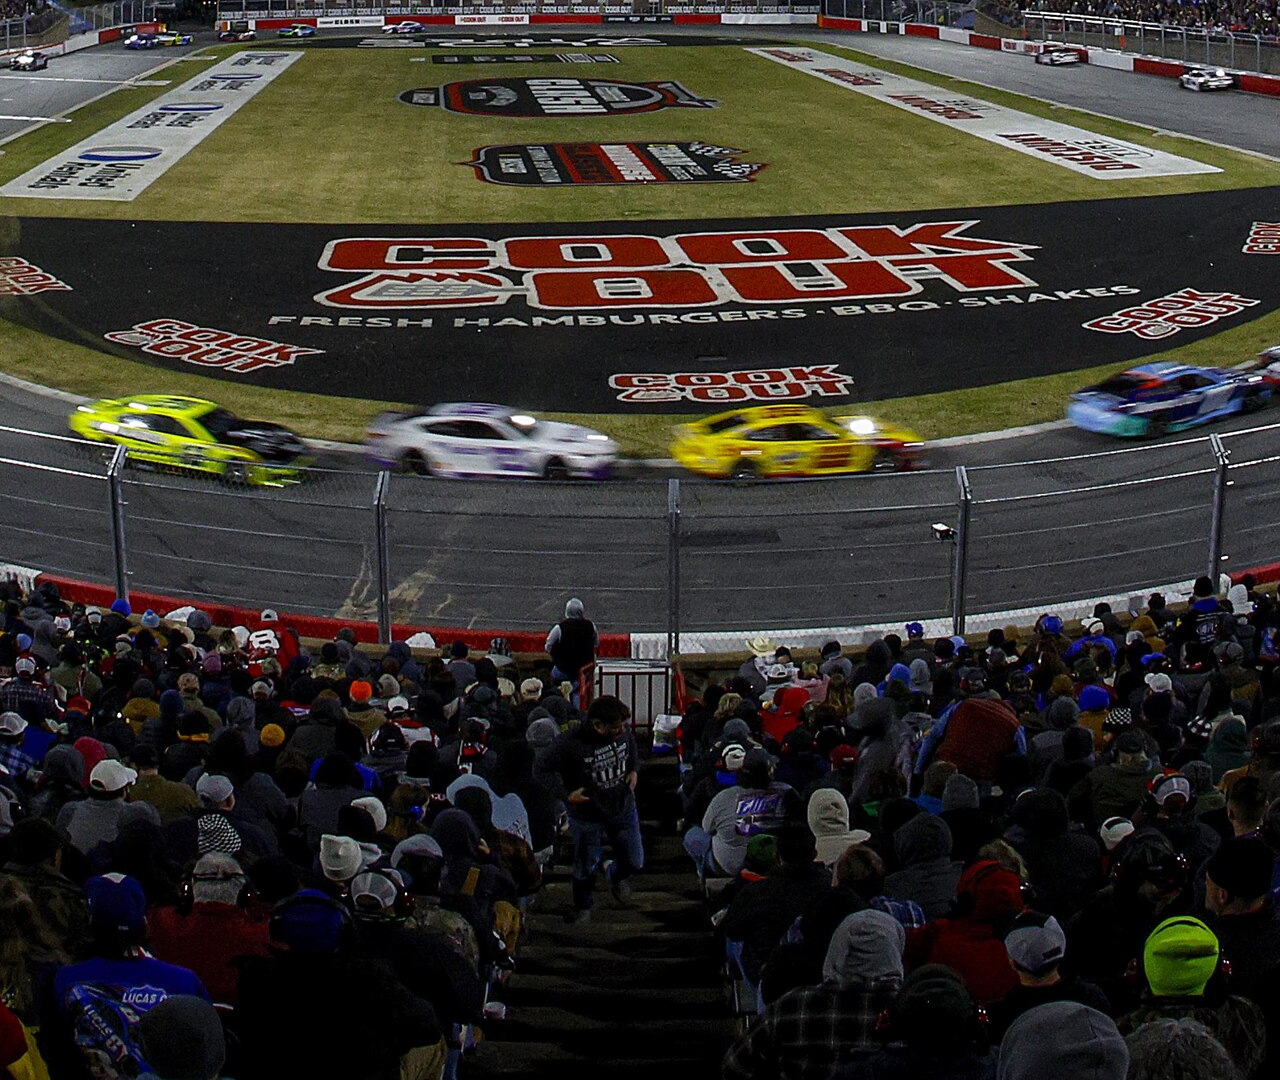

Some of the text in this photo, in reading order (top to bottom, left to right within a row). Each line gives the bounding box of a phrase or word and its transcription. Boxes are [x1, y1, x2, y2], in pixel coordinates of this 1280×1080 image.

[300, 9, 323, 17] COOK OUT
[525, 79, 608, 113] CLASH
[996, 132, 1141, 171] DISCOUNT
[1074, 139, 1140, 157] TIRE
[28, 161, 100, 190] Rentals
[78, 162, 145, 189] United
[317, 220, 1042, 272] COOK
[525, 252, 1040, 308] OUT
[268, 285, 1142, 329] FRESH HAMBURGERS BBQ SHAKES
[1082, 287, 1214, 334] COOK
[1172, 292, 1261, 329] OUT
[132, 318, 326, 366] COOK
[142, 338, 280, 374] OUT
[608, 364, 854, 390] COOK
[683, 377, 852, 402] OUT
[122, 992, 157, 1004] LUCAS
